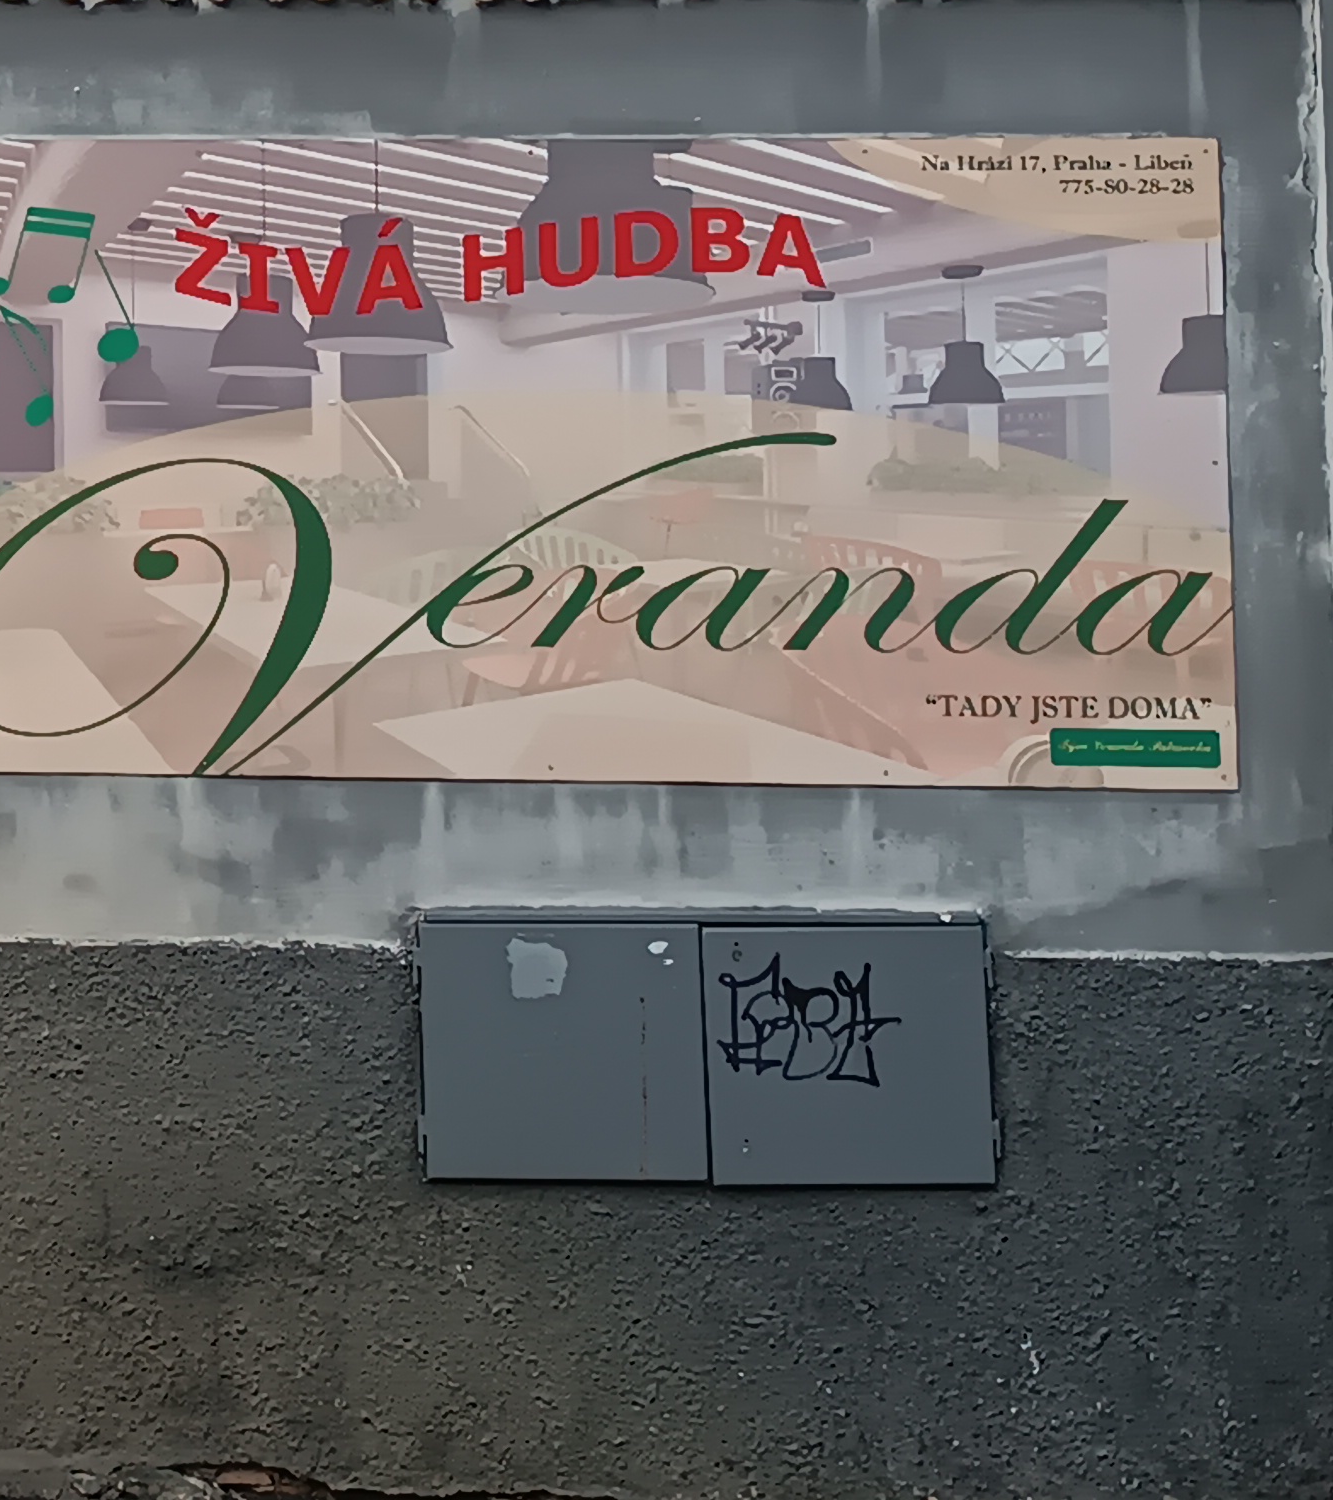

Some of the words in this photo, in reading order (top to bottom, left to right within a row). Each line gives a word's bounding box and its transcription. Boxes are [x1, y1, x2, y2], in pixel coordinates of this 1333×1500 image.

[921, 155, 950, 171] Na
[1020, 155, 1047, 173] 17,
[1053, 154, 1112, 171] Praha
[172, 206, 423, 316] ŽIVÁ
[461, 205, 827, 302] HUDBA
[1029, 695, 1100, 724] JSTE
